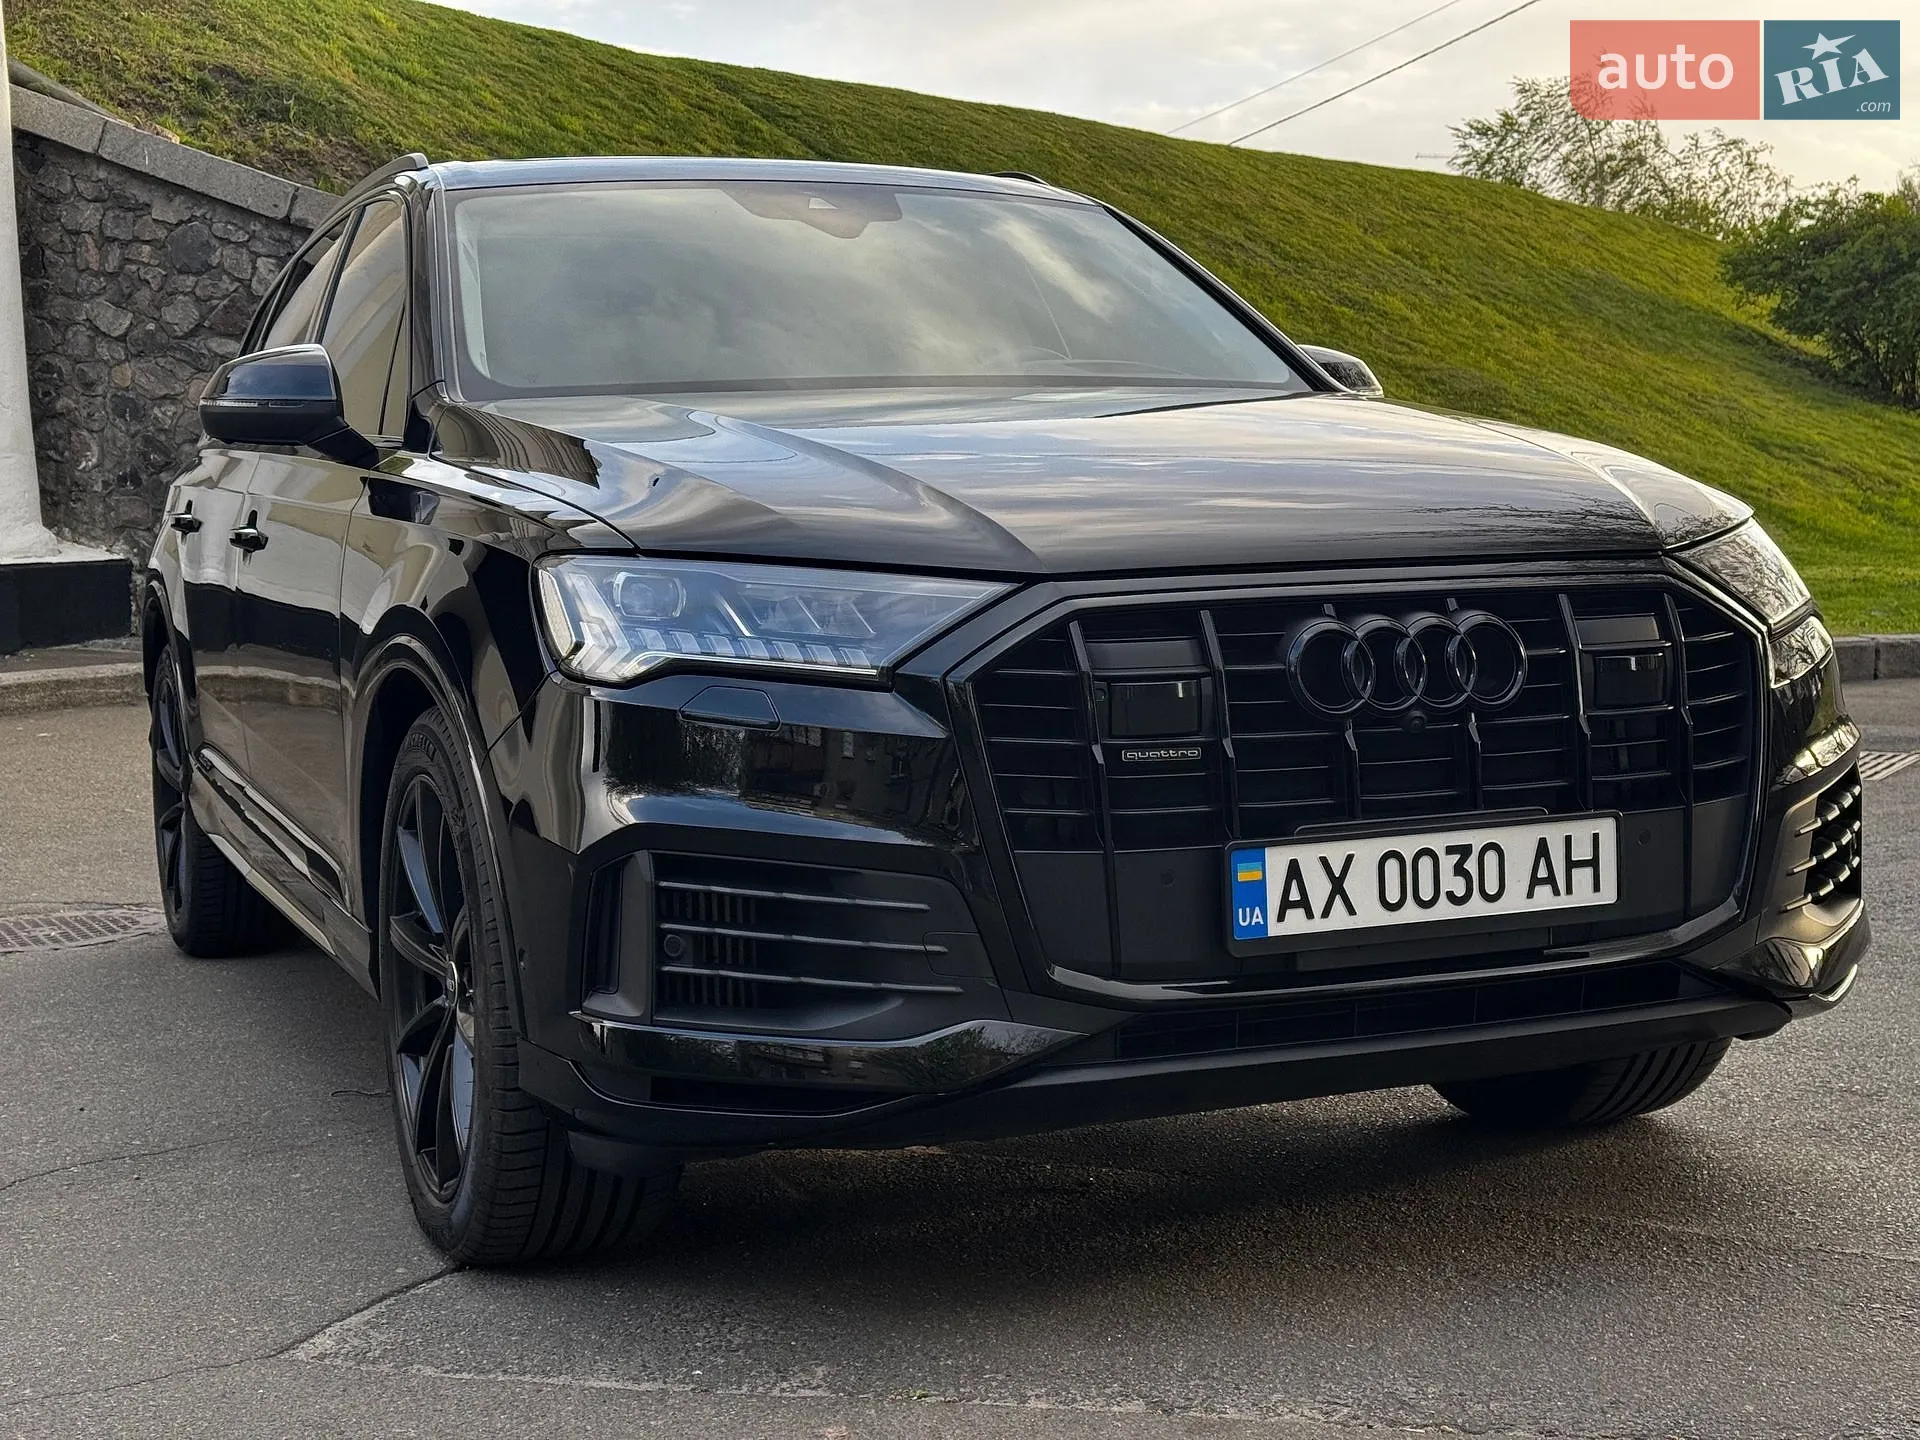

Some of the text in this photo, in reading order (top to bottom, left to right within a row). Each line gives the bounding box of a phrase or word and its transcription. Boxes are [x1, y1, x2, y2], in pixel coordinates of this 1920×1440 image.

[1126, 749, 1199, 760] quattro
[1276, 831, 1601, 922] AX 0030 AH
[1238, 907, 1264, 927] UA
